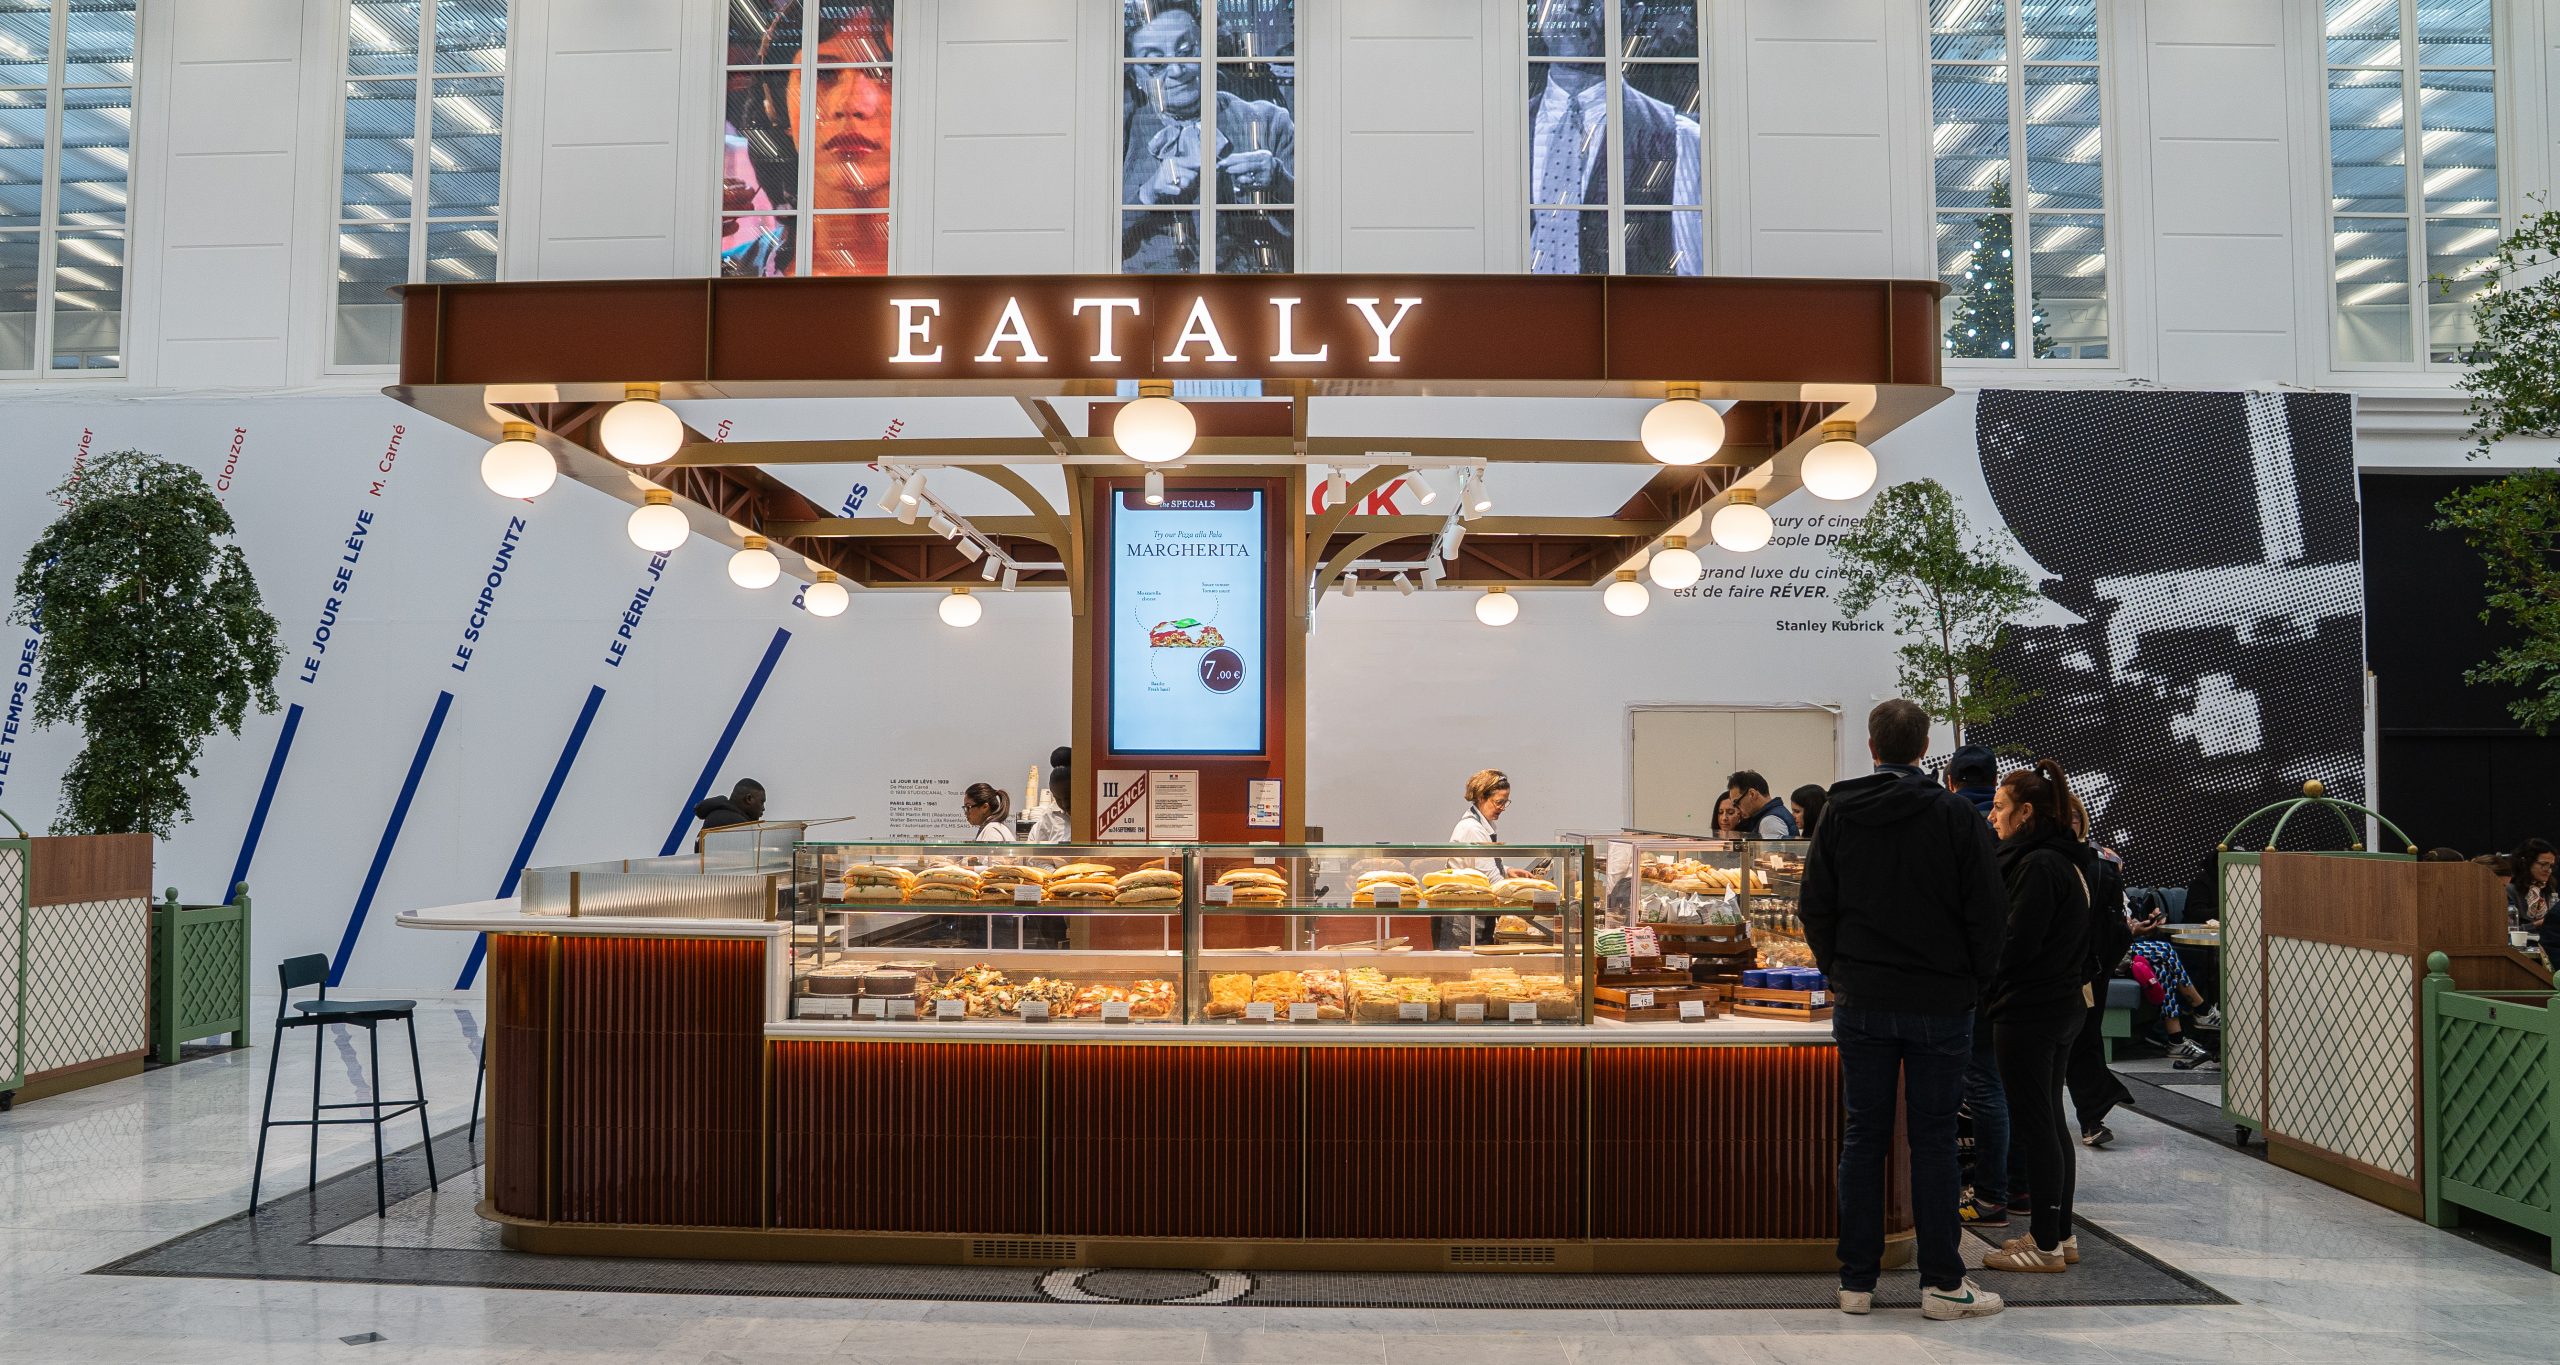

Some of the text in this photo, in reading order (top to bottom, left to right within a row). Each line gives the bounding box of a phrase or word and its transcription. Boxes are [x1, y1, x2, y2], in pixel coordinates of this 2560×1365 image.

[888, 295, 1423, 363] EATALY
[217, 426, 247, 491] Clouzot
[1171, 500, 1216, 508] SPECIALS
[1807, 514, 1825, 527] of
[1154, 530, 1163, 540] Try
[1178, 530, 1193, 539] Pizza
[1195, 530, 1206, 538] alla
[1209, 530, 1222, 538] Pala
[1767, 535, 1811, 549] eople
[300, 424, 406, 684] LE JOUR SE LÈVE M. Carné
[1126, 543, 1250, 557] MARGHERITA
[1750, 565, 1784, 579] luxe
[1789, 565, 1809, 579] du
[451, 516, 527, 672] LE SCHPOUNTZ
[1673, 586, 1698, 598] est
[1703, 585, 1723, 598] de
[1728, 585, 1765, 598] faire
[605, 550, 673, 668] LE PÉRIL JEU
[1776, 619, 1885, 634] Stanley Kubrick
[1234, 671, 1241, 680] €
[1, 681, 28, 745] TEMPS
[18, 638, 39, 678] DES
[1103, 782, 1119, 797] III
[1100, 777, 1145, 833] LICENCE
